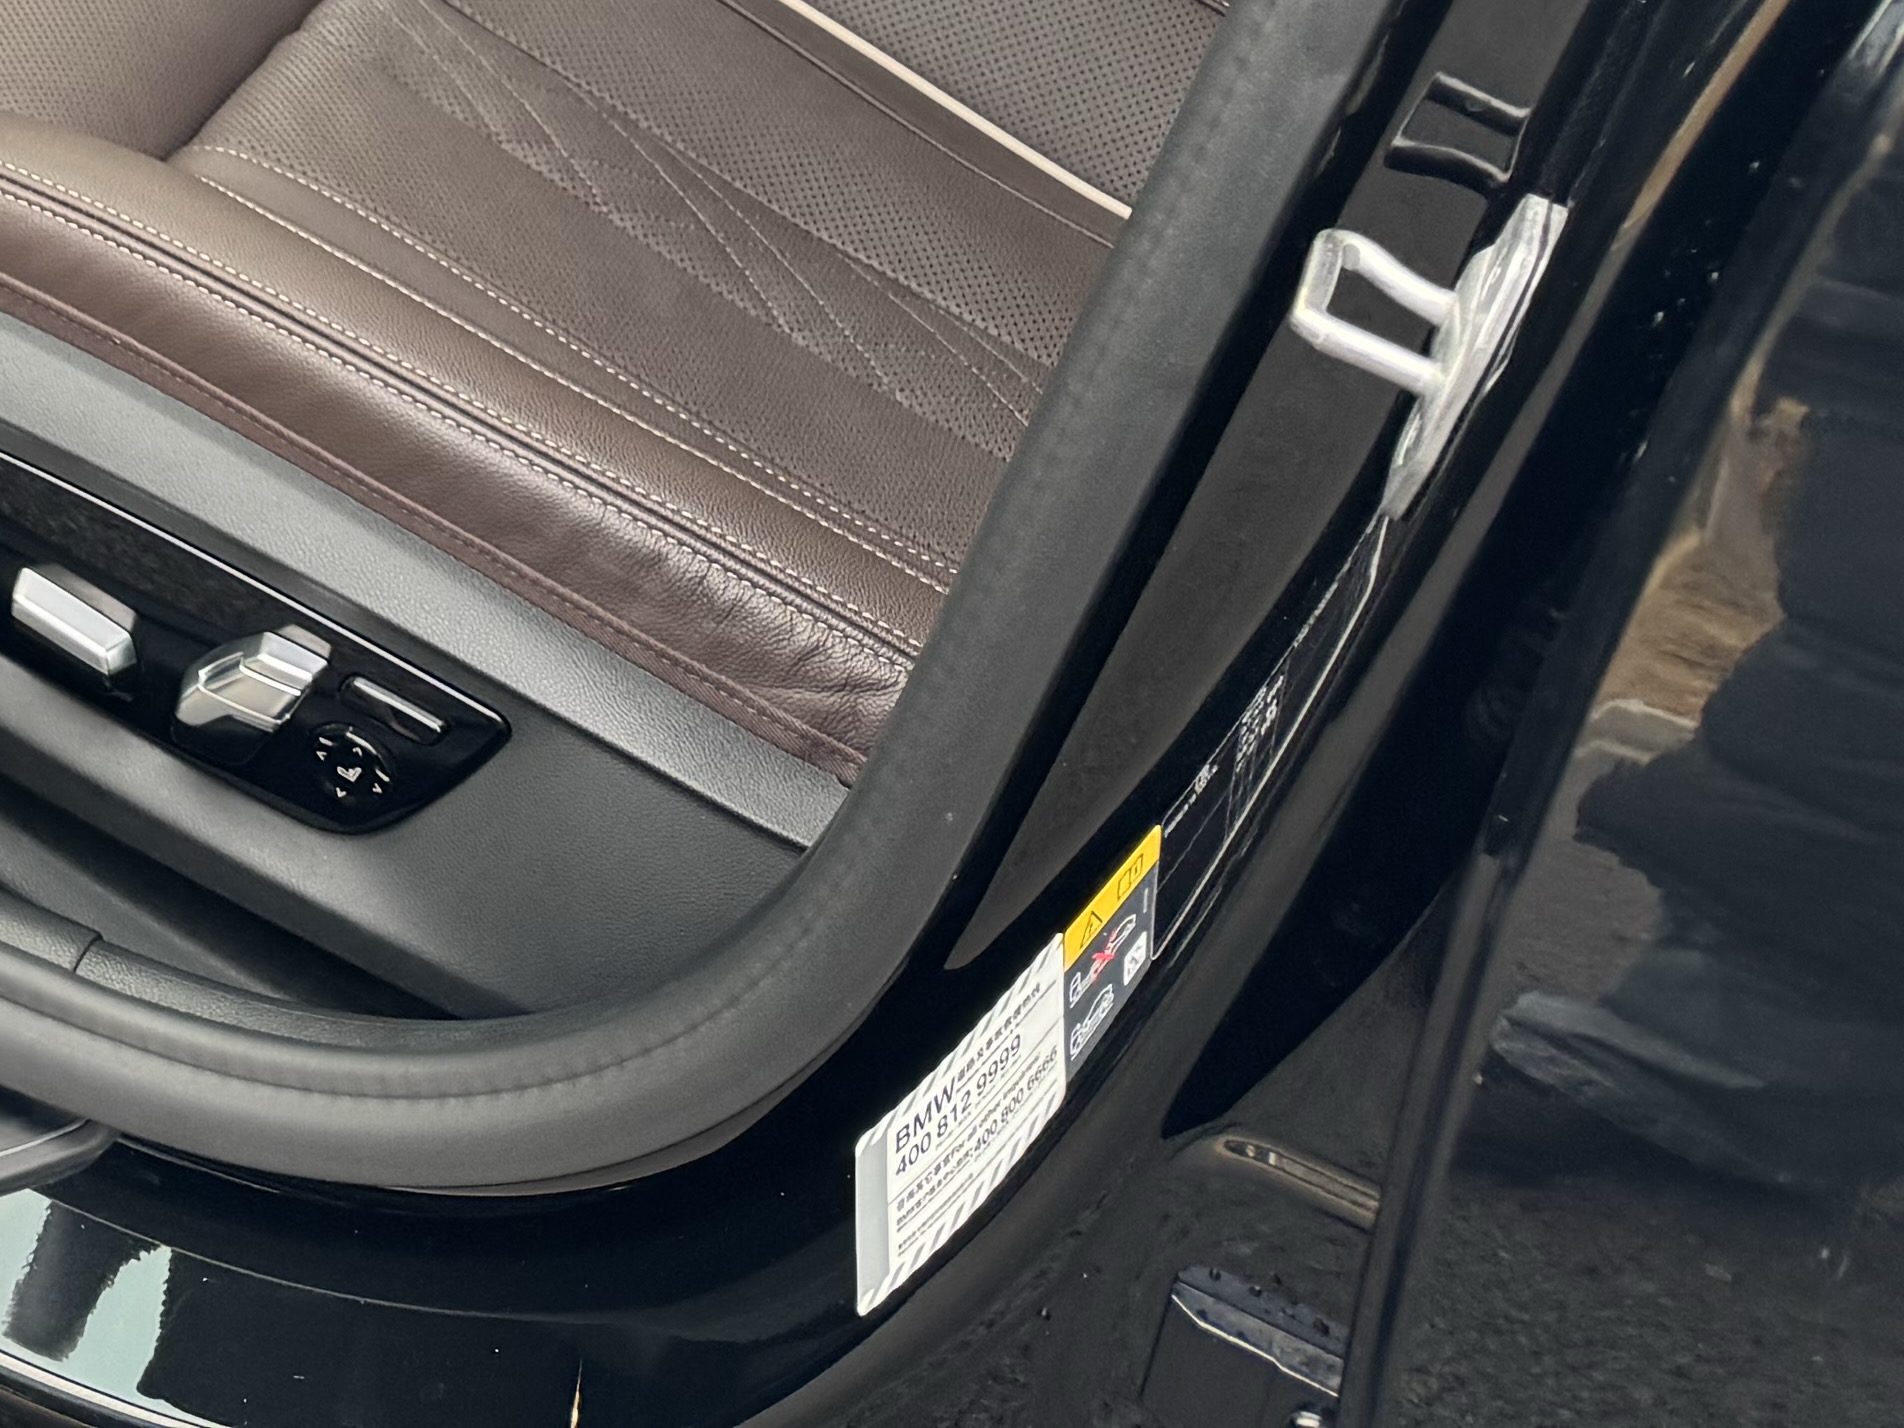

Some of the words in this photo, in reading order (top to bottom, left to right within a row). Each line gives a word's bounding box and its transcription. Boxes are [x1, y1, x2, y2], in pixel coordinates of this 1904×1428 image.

[895, 1134, 932, 1177] 400
[936, 1090, 972, 1138] 812
[976, 1034, 1022, 1096] 9999
[973, 1119, 998, 1153] 400
[1001, 1088, 1024, 1125] 800
[1026, 1045, 1058, 1092] 6666
